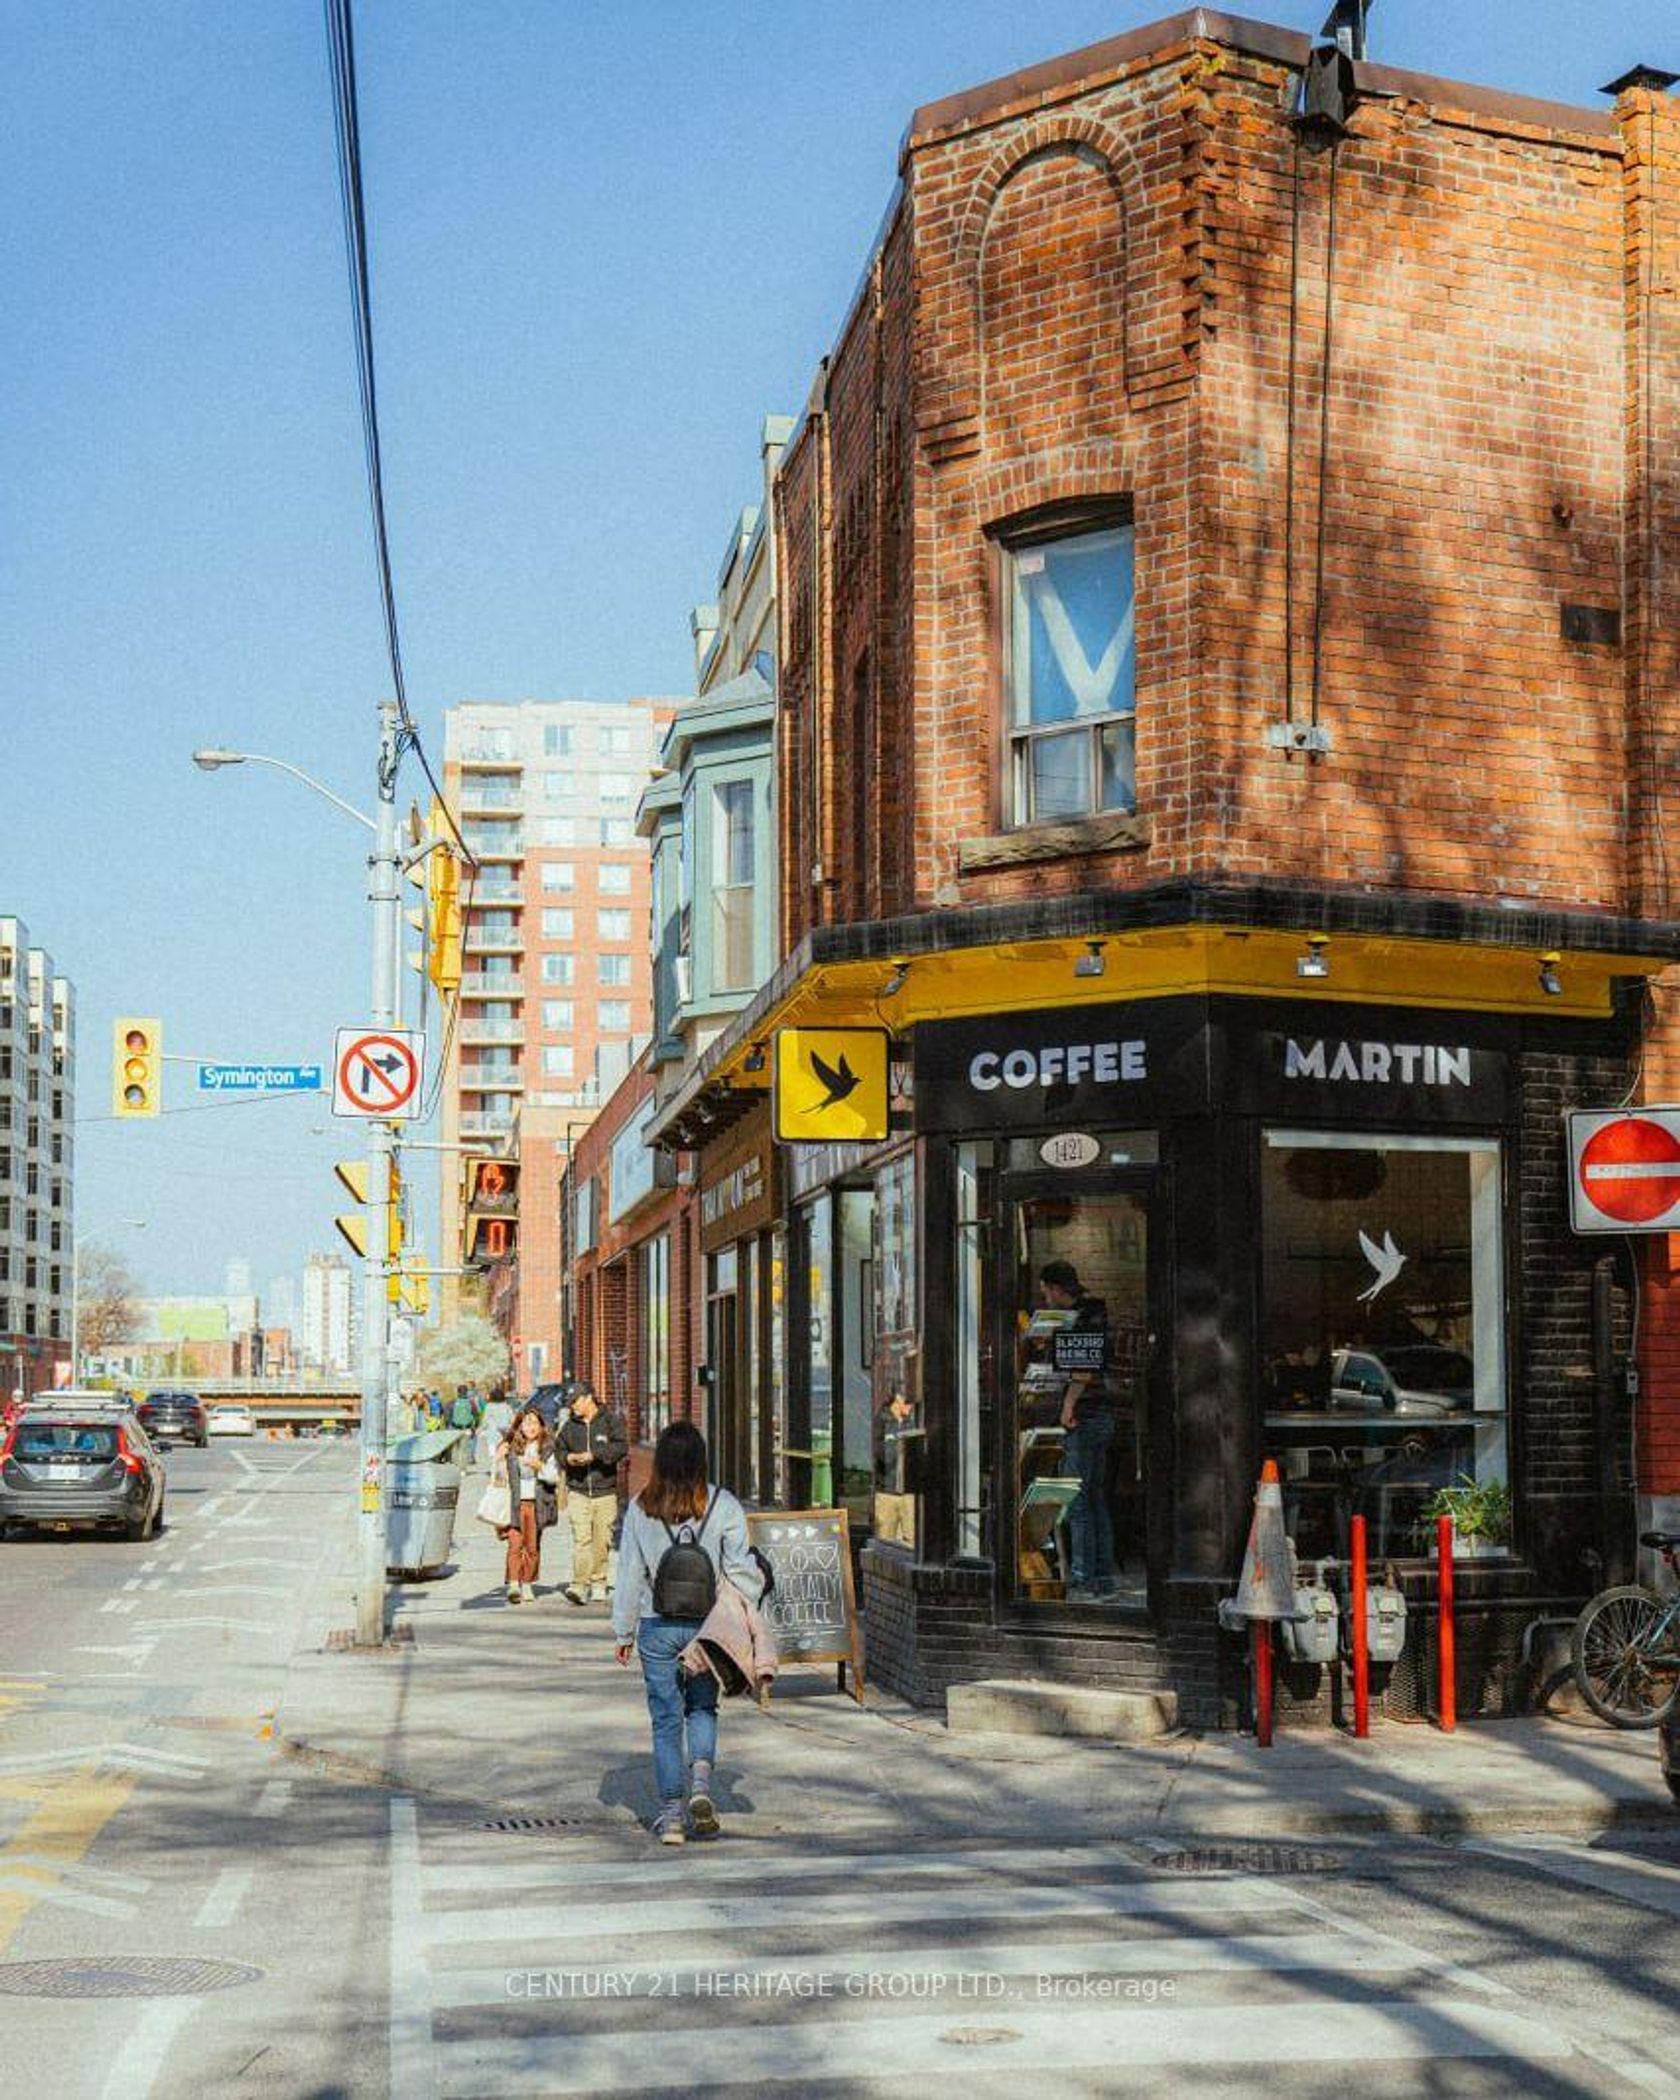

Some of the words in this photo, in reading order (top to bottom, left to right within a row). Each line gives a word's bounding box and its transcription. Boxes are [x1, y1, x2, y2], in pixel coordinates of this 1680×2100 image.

[205, 1067, 294, 1089] Symington
[969, 1040, 1147, 1091] COFFEE
[1285, 1038, 1471, 1086] MARTIN
[1055, 1138, 1082, 1162] 1421
